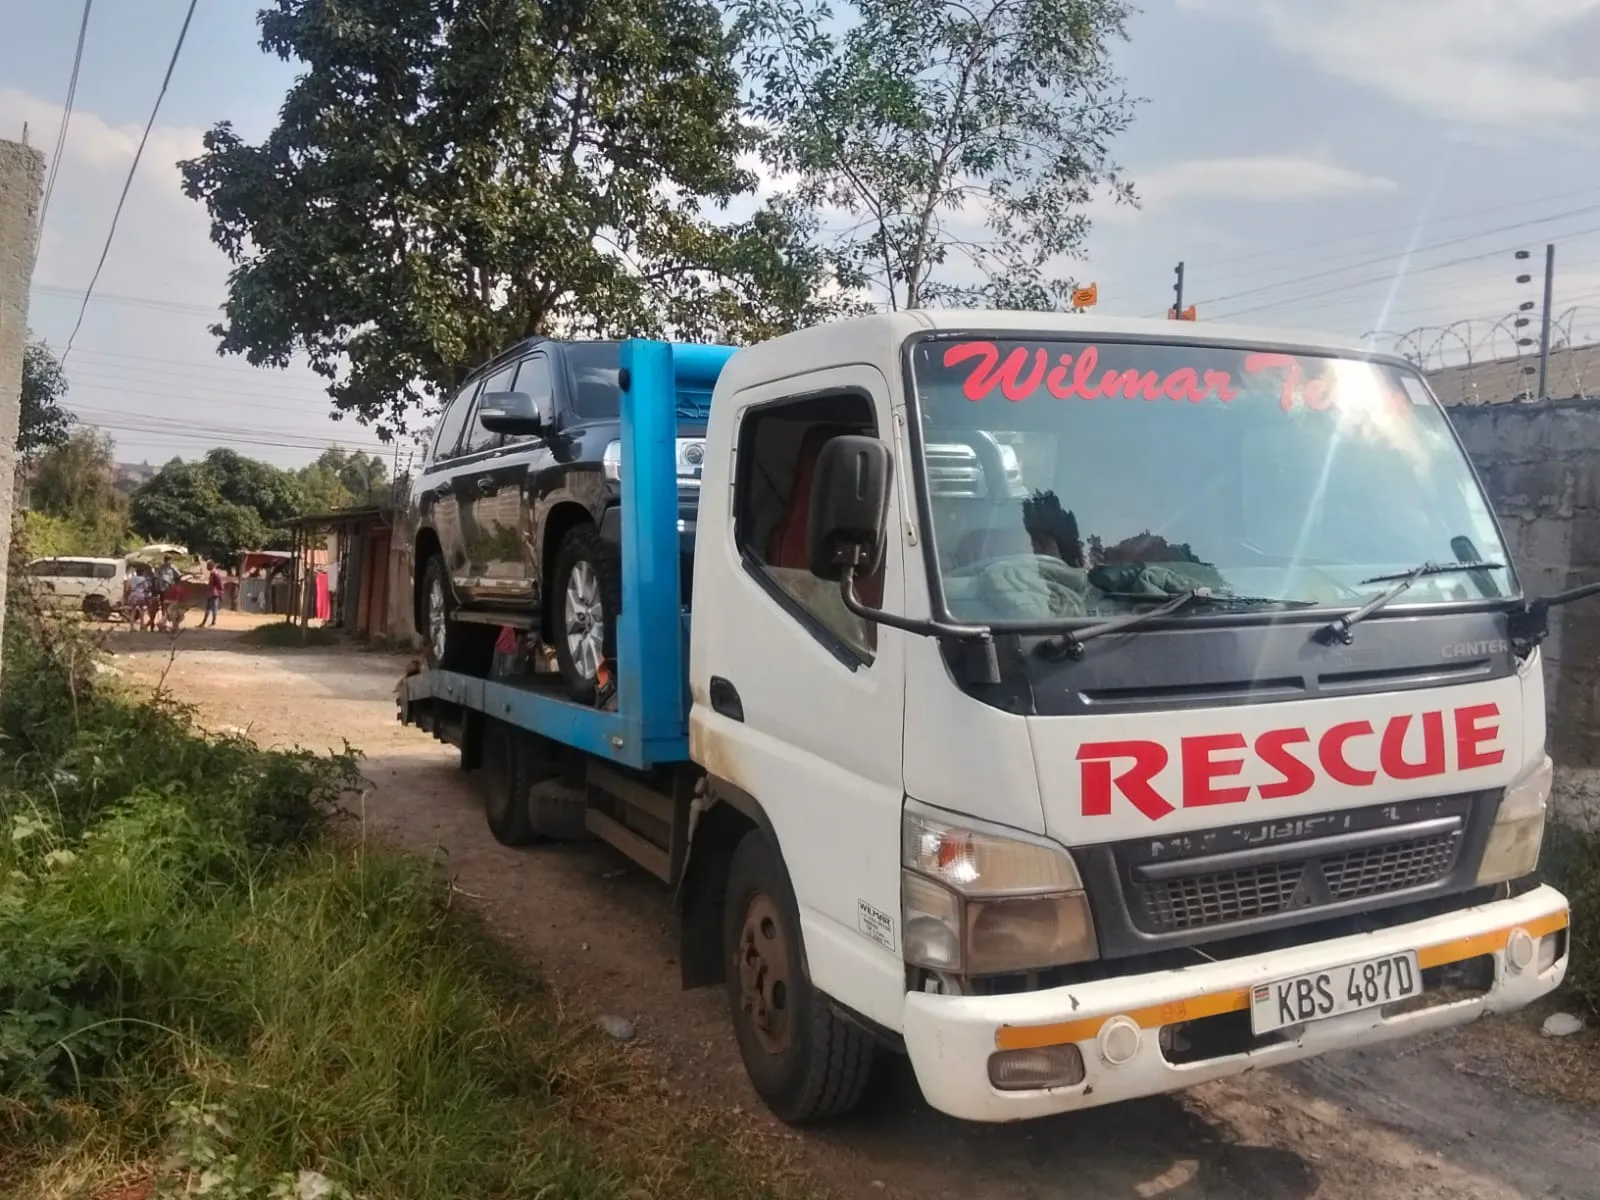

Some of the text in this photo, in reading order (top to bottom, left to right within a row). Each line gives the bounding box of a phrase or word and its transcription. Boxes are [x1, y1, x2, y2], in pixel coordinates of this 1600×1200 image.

[943, 341, 1237, 402] Wilmar
[1441, 638, 1509, 659] CANTER
[1075, 702, 1505, 821] RESCUE
[1277, 955, 1414, 1025] KBS 487D
